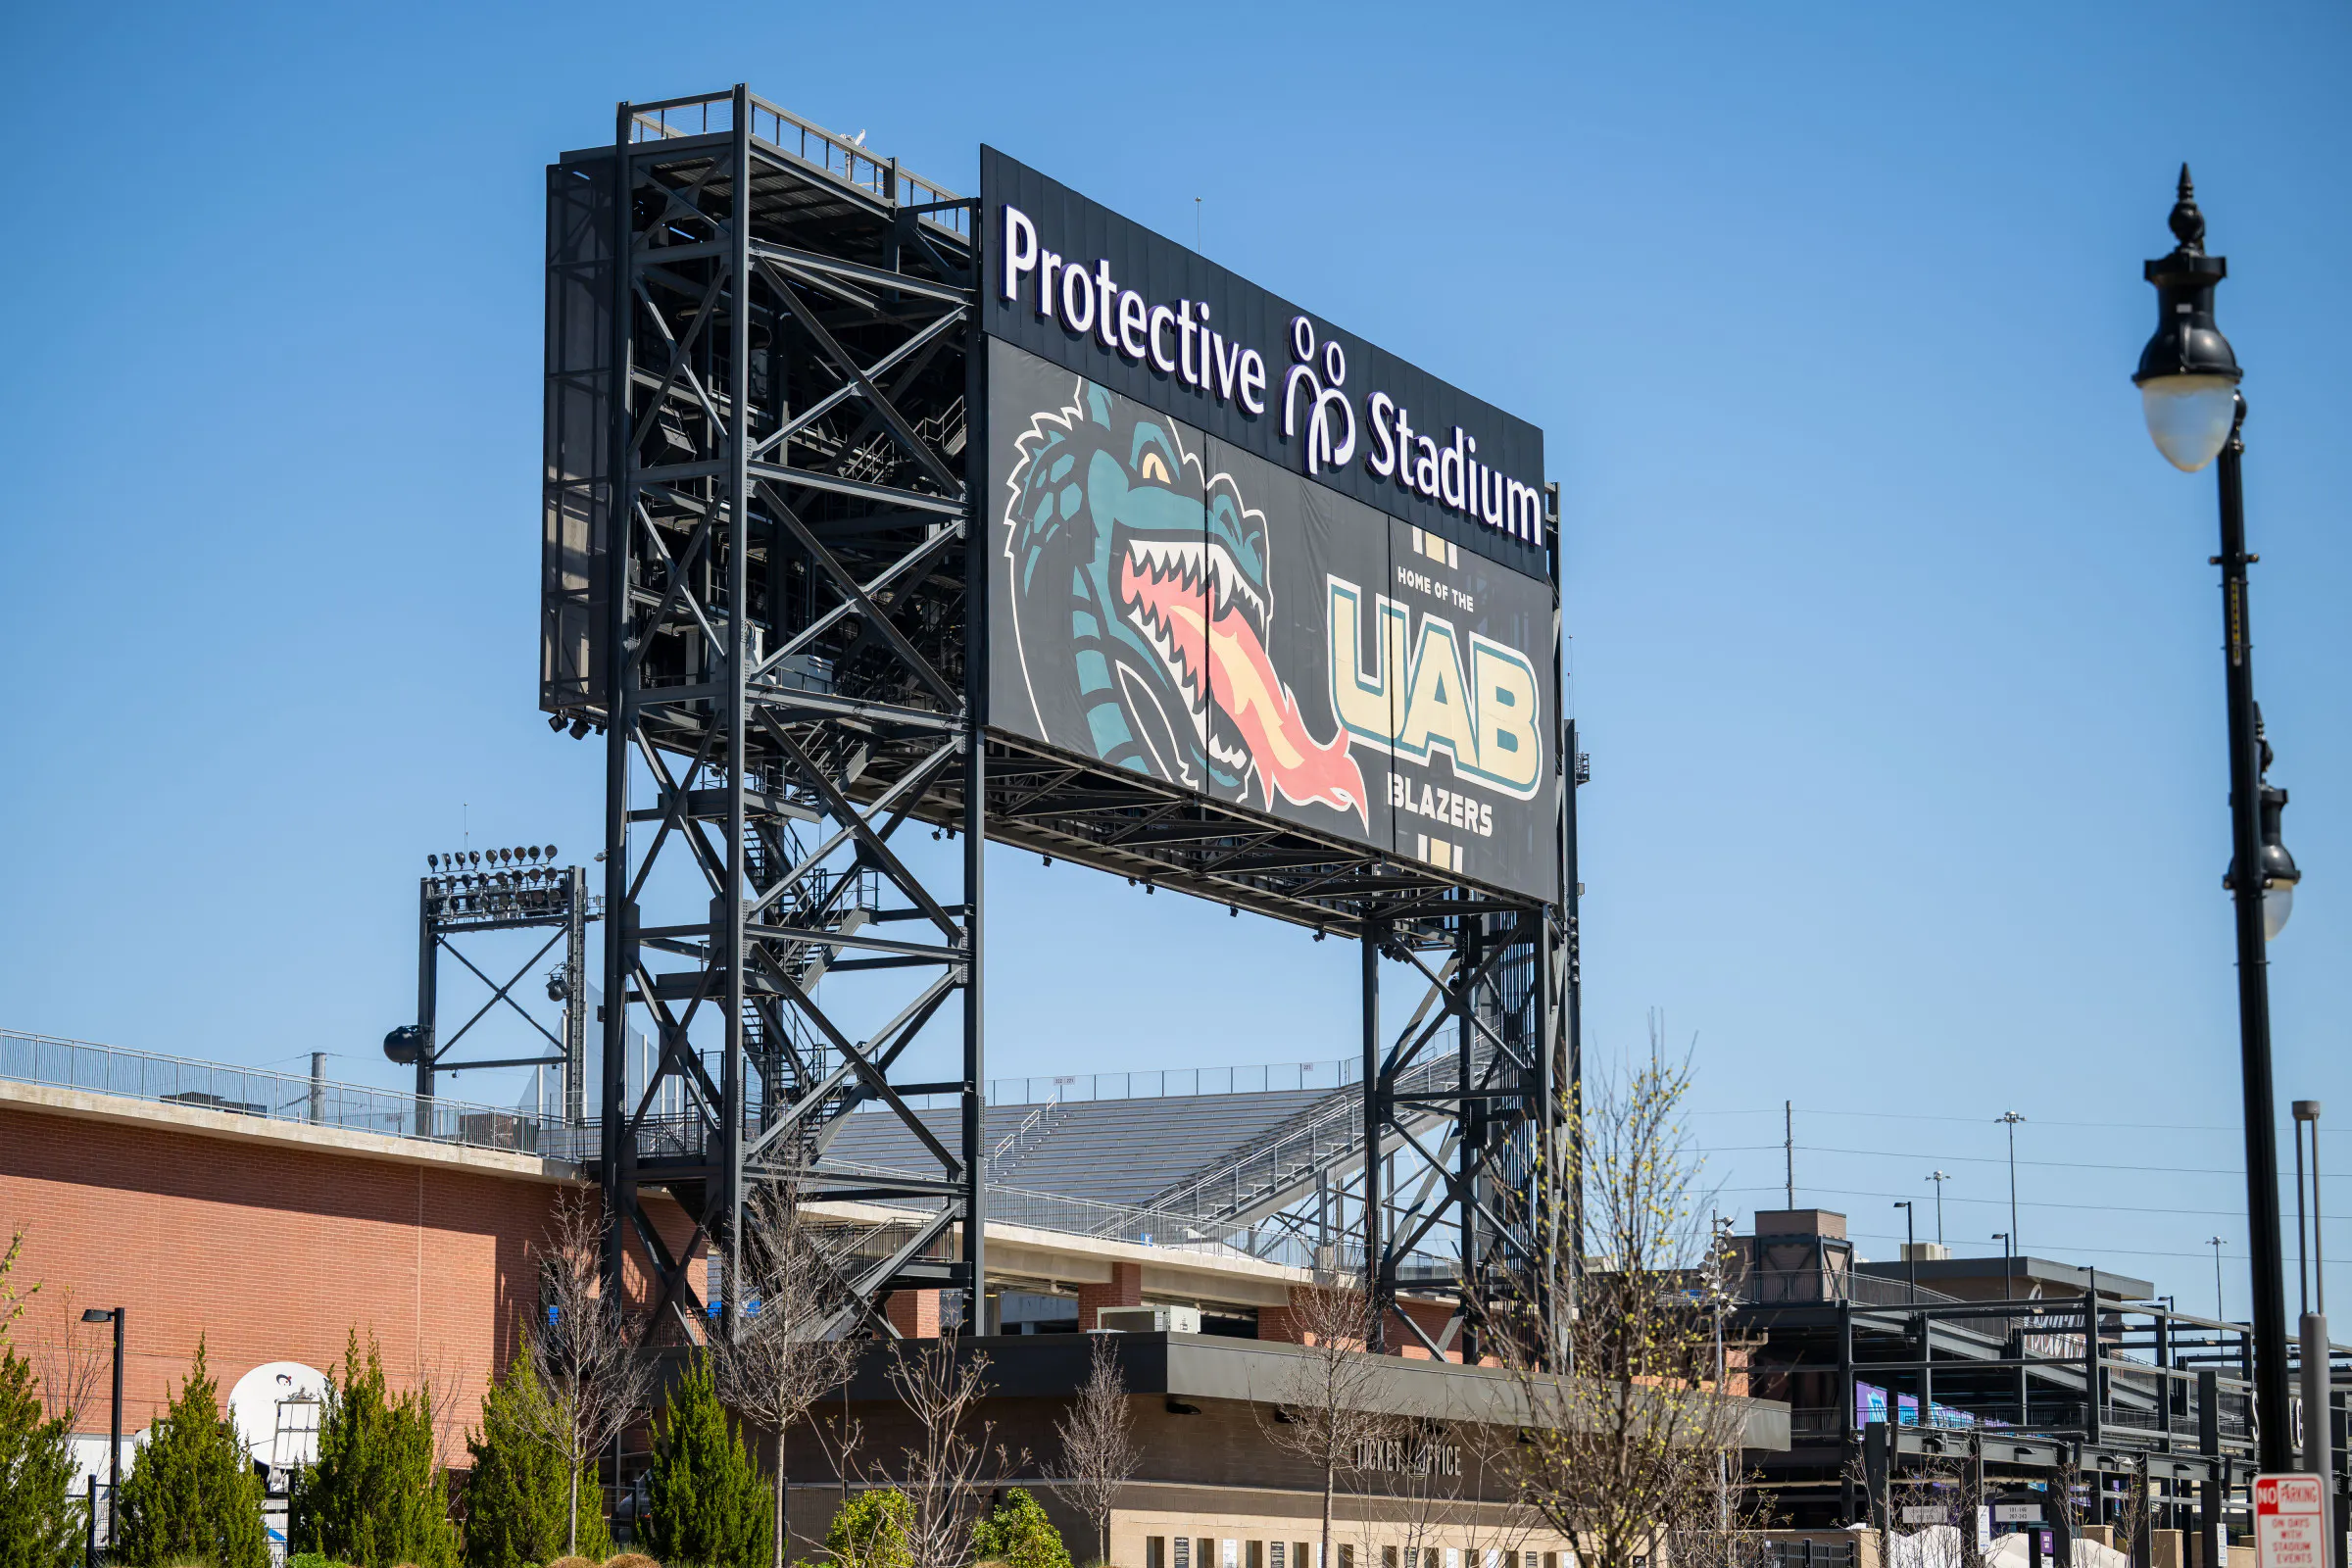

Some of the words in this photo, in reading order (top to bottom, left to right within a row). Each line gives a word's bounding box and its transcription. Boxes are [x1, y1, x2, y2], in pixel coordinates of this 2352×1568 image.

[1000, 204, 1265, 415] Protective
[1366, 391, 1542, 546] Stadium
[1397, 565, 1432, 595] HOME
[1435, 581, 1448, 601] OF
[1452, 588, 1474, 612] THE
[1327, 573, 1543, 801] UAB
[1387, 771, 1494, 837] BLAZERS
[1356, 1438, 1402, 1472] TICKET
[2258, 1487, 2278, 1504] NO
[2280, 1486, 2317, 1503] PARKING
[2272, 1518, 2285, 1528] ON
[2287, 1518, 2310, 1528] DAYS
[2280, 1530, 2302, 1540] WITH
[2273, 1542, 2311, 1551] STADIUM
[2277, 1553, 2313, 1564] EVENTS
